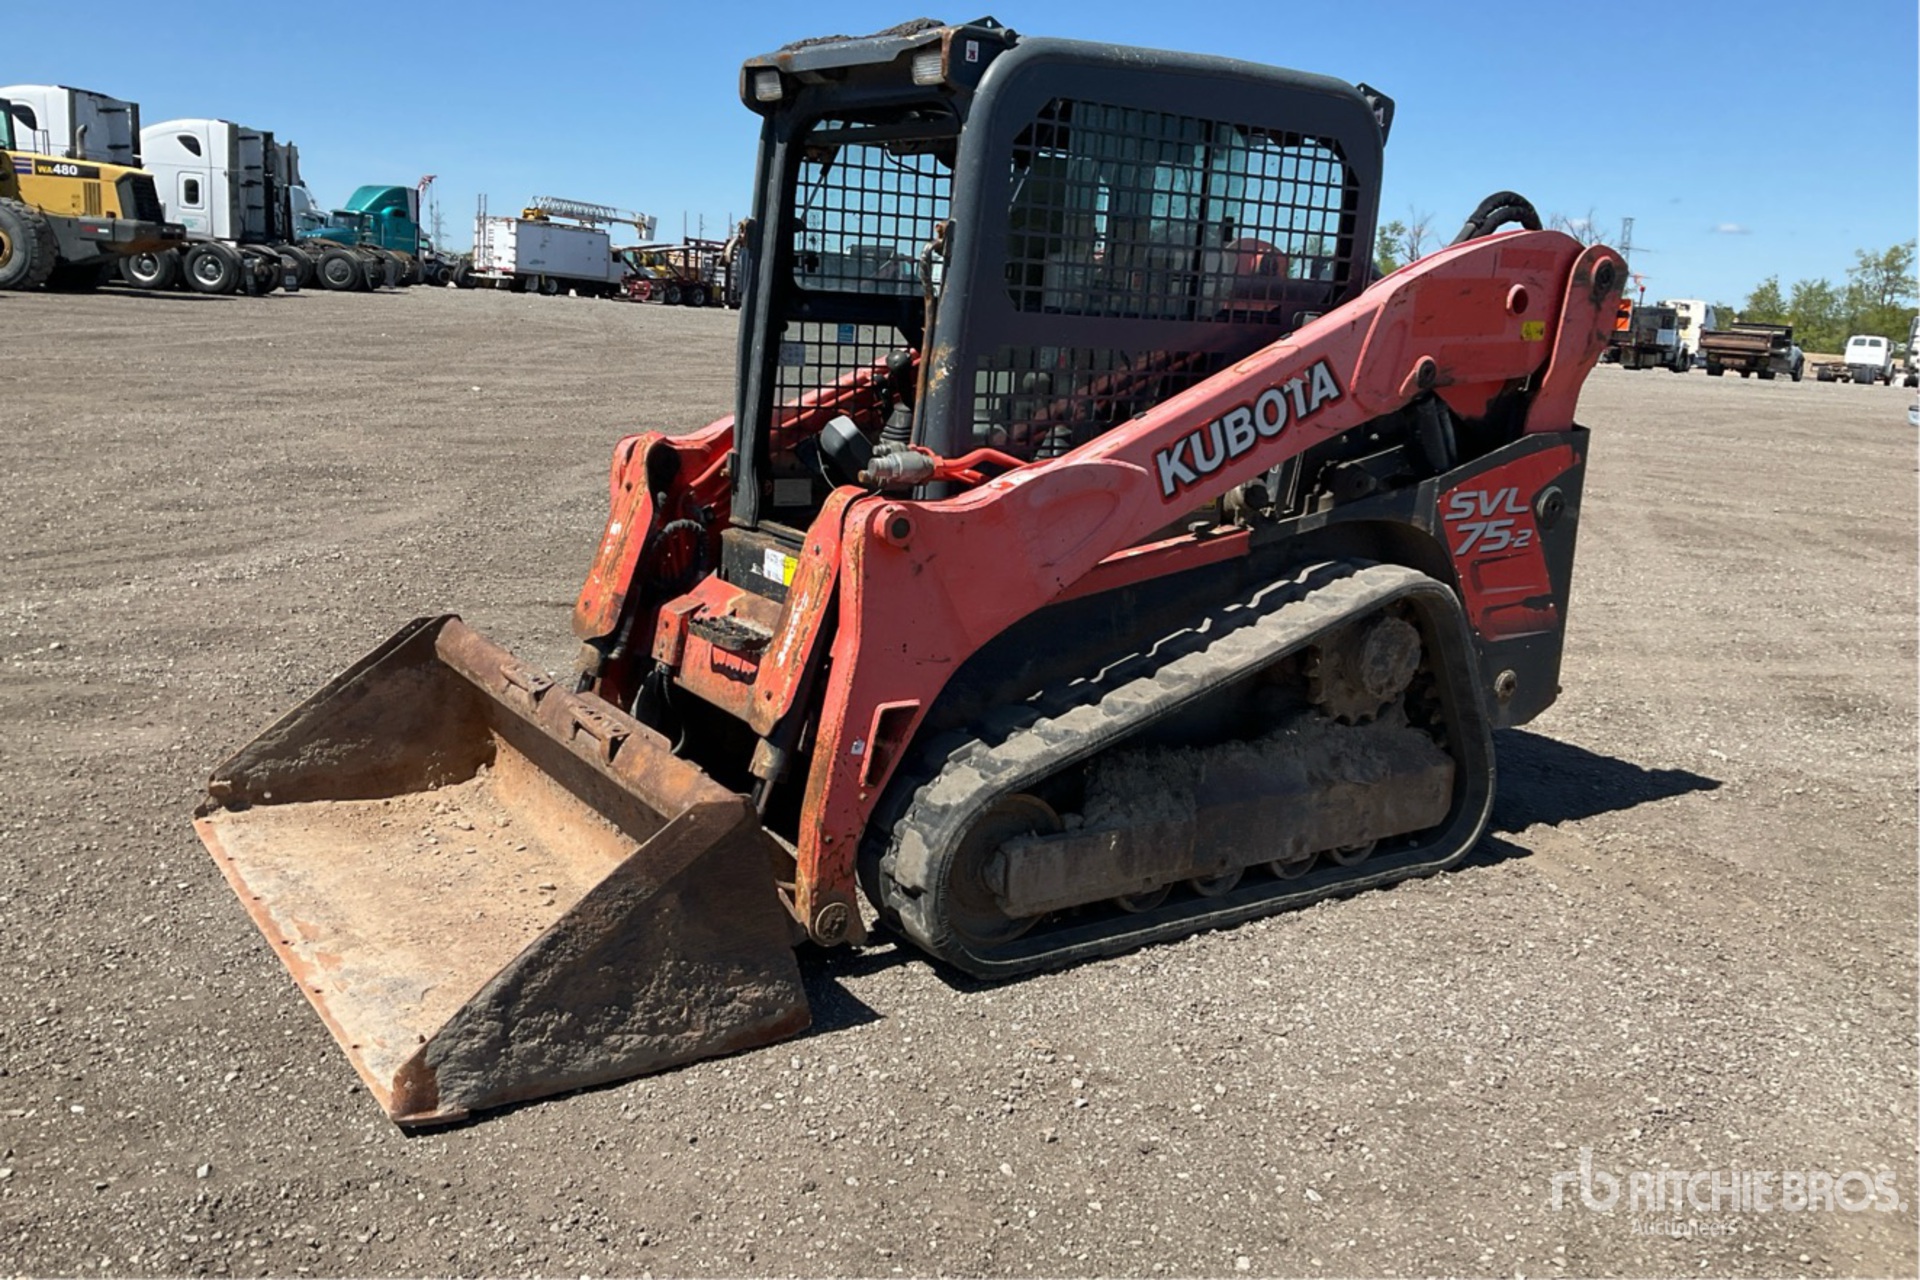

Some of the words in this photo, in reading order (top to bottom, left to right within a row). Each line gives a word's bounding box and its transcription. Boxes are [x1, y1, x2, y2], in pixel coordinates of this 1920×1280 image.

[37, 163, 78, 176] WA480
[1156, 360, 1340, 497] KUBOTA
[1444, 487, 1530, 521] SVL
[1454, 518, 1533, 556] 75-2
